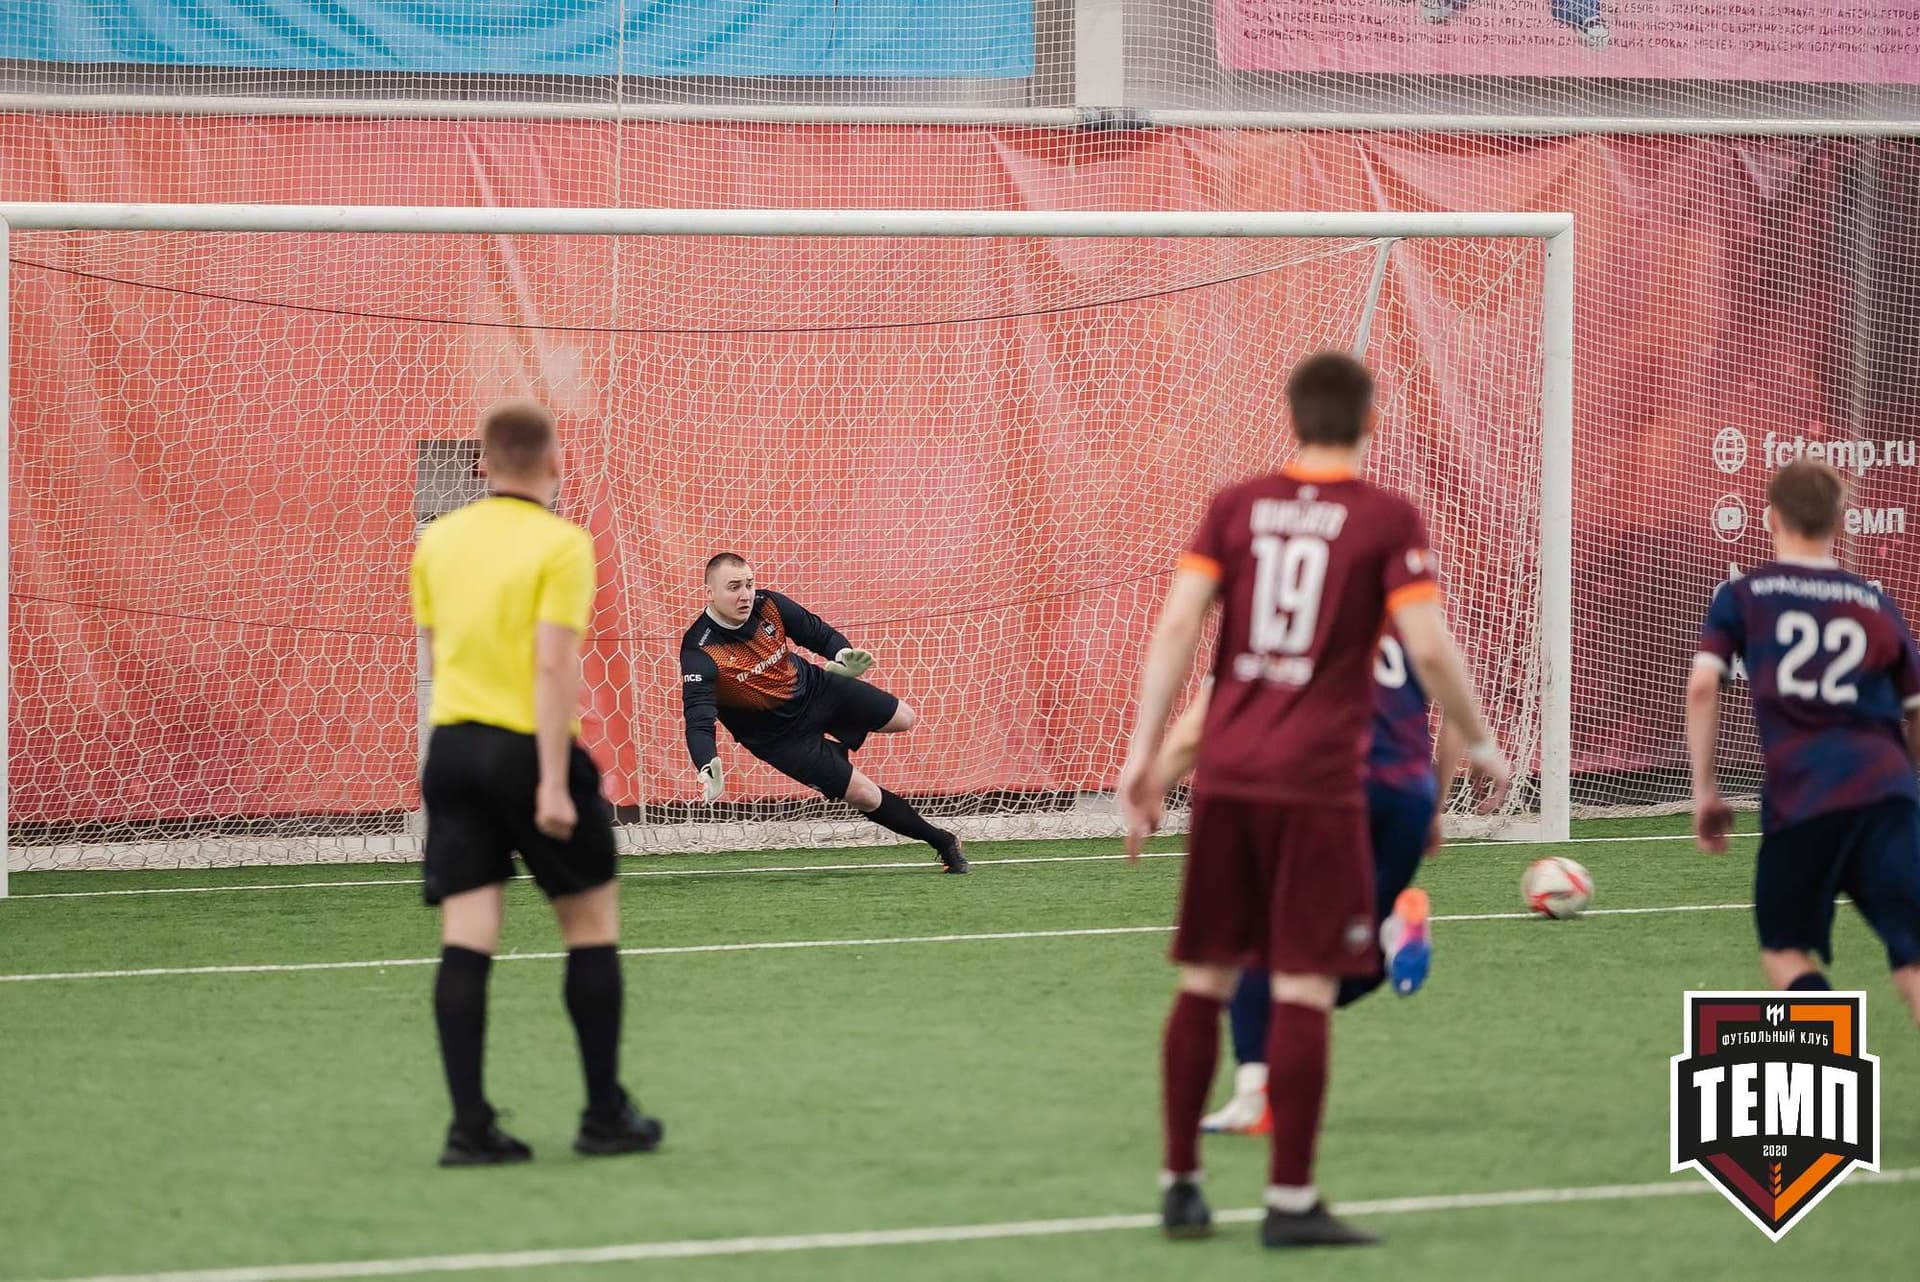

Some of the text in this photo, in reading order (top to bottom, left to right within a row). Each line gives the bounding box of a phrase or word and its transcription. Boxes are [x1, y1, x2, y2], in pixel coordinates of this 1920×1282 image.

[1763, 430, 1915, 476] fctemp.ru
[1845, 507, 1905, 535] емп
[1250, 534, 1329, 654] 19
[684, 673, 703, 683] ПСБ
[1776, 610, 1867, 705] 22
